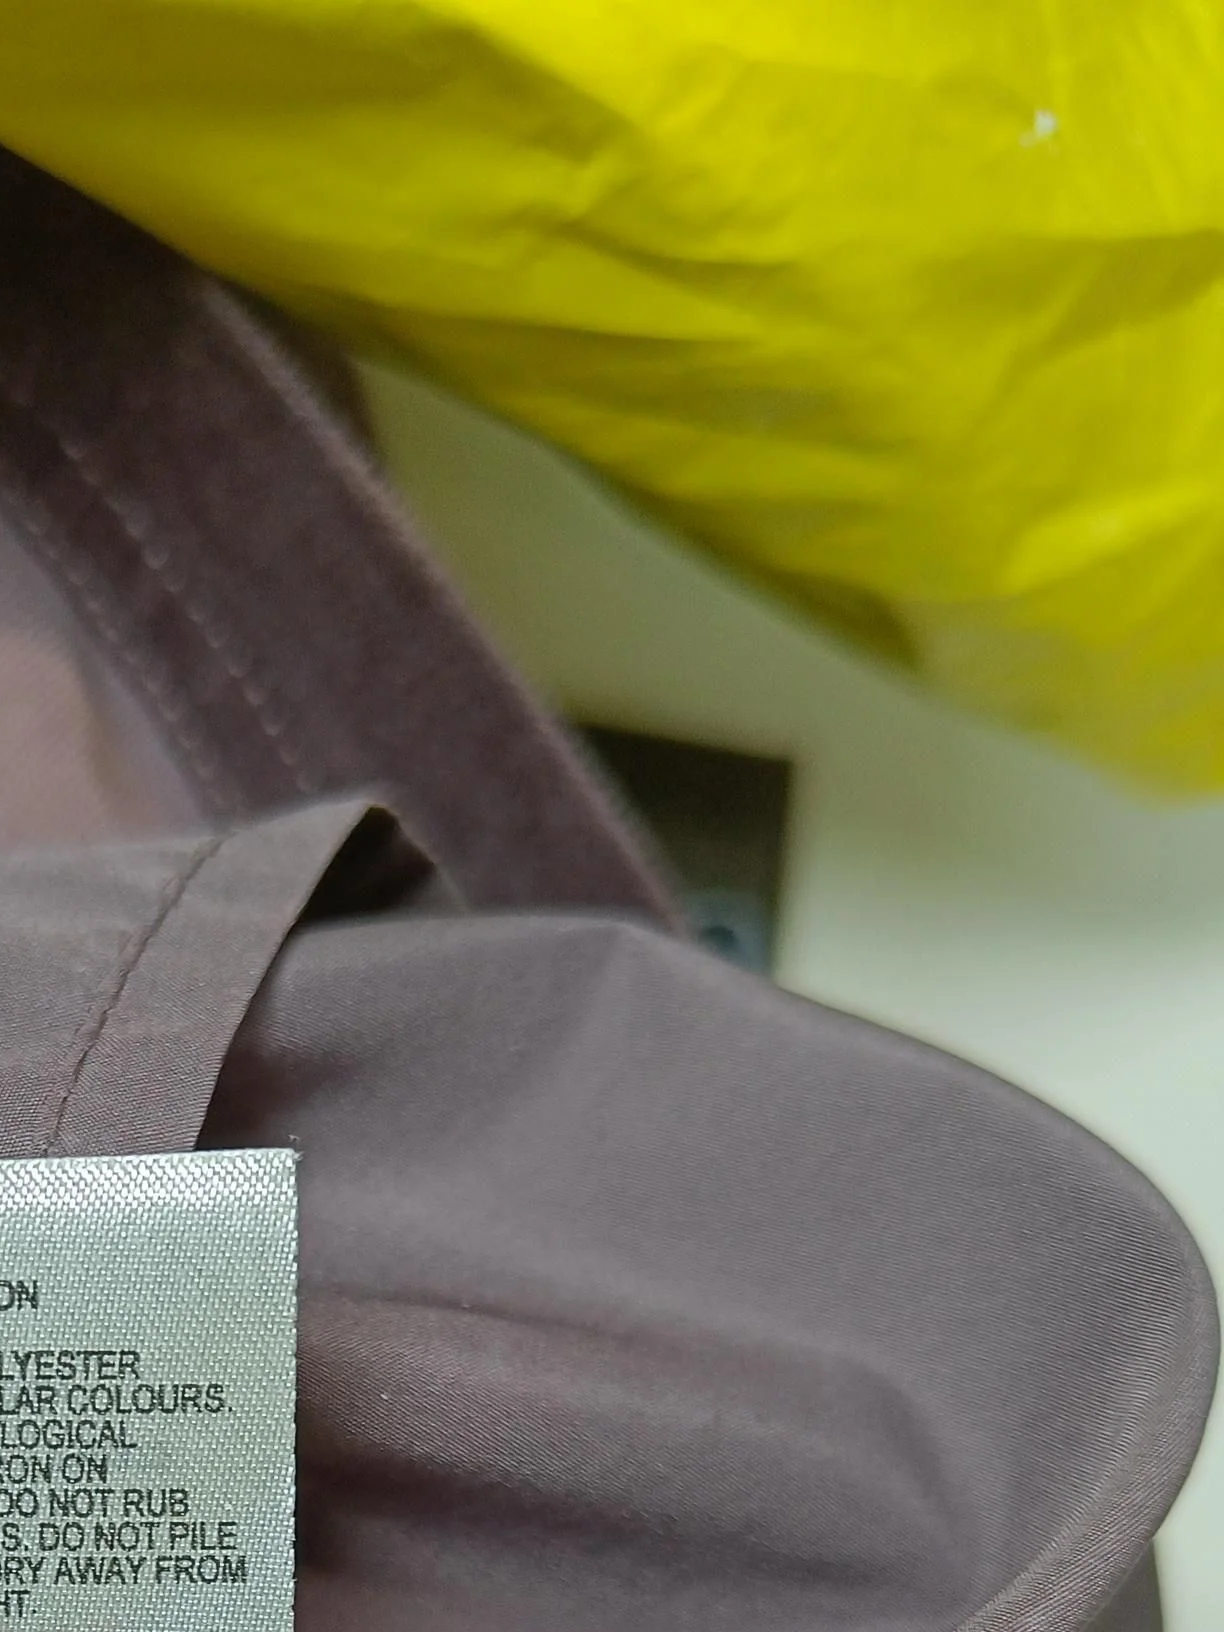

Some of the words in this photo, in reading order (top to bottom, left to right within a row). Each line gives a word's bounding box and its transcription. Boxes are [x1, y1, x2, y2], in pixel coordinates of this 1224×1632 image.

[67, 1384, 234, 1415] COLOURS.
[63, 1454, 107, 1484] ON
[49, 1489, 113, 1518] NOT
[124, 1488, 190, 1517] RUB
[39, 1523, 83, 1552] DO
[94, 1522, 159, 1552] NOT
[169, 1521, 237, 1551] PILE
[53, 1556, 146, 1585] AWAY
[156, 1555, 249, 1584] FROM
